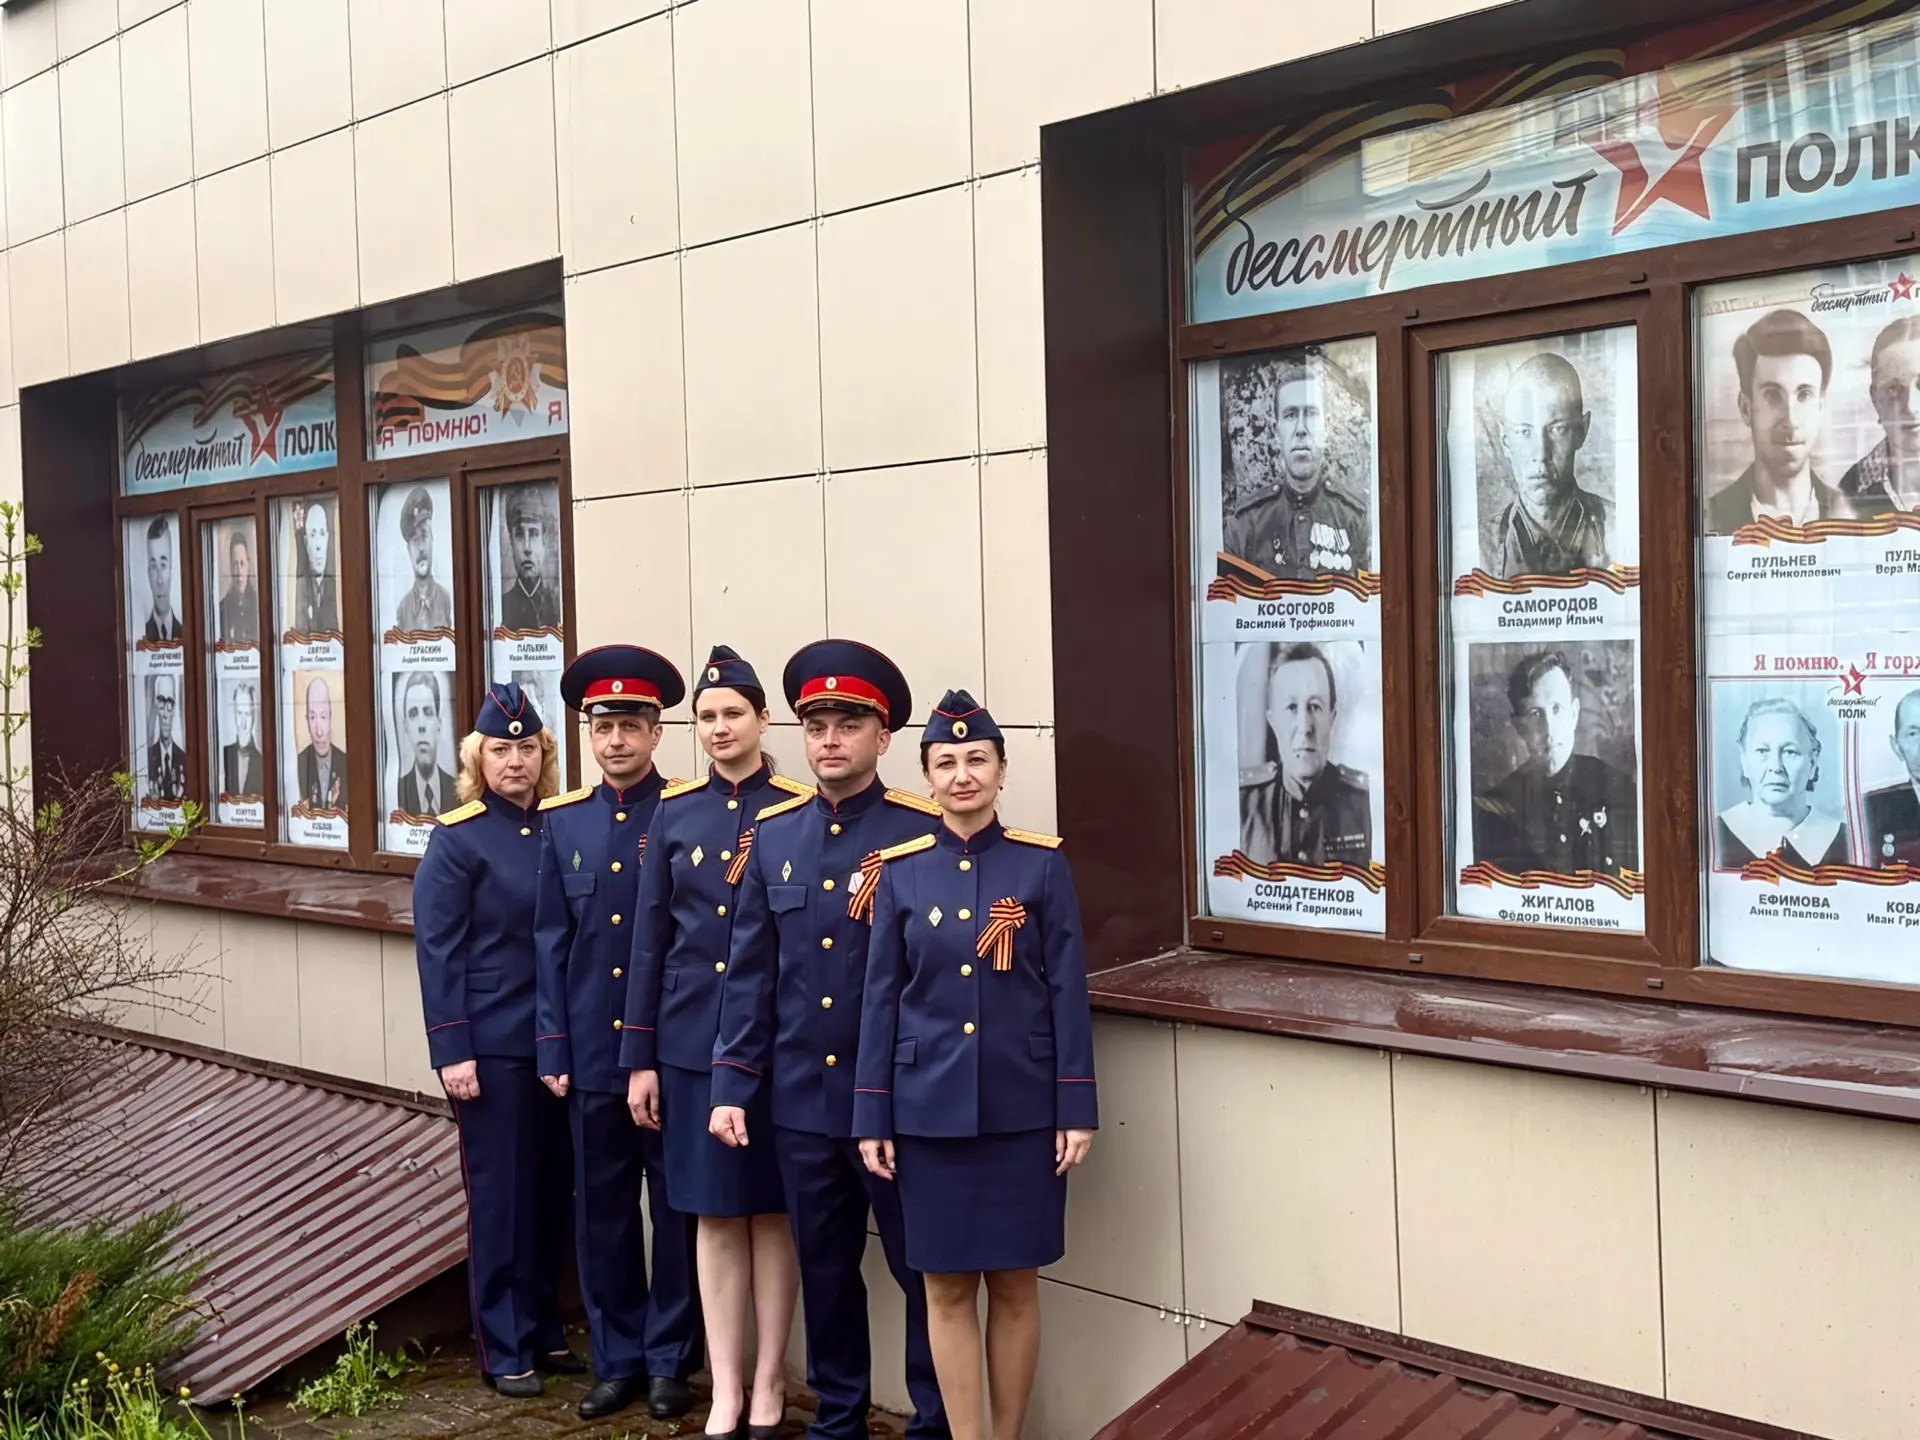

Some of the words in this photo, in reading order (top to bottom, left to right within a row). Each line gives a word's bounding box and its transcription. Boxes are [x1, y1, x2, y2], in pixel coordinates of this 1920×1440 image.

[1226, 158, 1598, 294] бессмертный
[1736, 116, 1920, 204] ПОЛК
[1810, 284, 1890, 312] бессмертный
[382, 426, 395, 450] Я
[408, 413, 488, 447] ПОМНЮ!
[548, 401, 562, 426] Я
[135, 428, 246, 484] бессмертный
[284, 420, 336, 457] ПОЛК
[1751, 554, 1817, 568] ПУЛЬНЕВ
[1727, 570, 1767, 582] Сергей
[1770, 567, 1841, 579] Николаевич
[1875, 563, 1903, 577] Вера
[1257, 602, 1335, 616] КОСОГОРОВ
[1502, 597, 1598, 614] САМОРОДОВ
[1236, 617, 1286, 630] Василий
[1290, 617, 1355, 631] Трофимович
[1497, 614, 1562, 628] Владимир
[1566, 613, 1604, 626] Ильич
[517, 643, 548, 653] ПАЛЬКИН
[1753, 654, 1767, 671] Я
[1865, 652, 1877, 670] Я
[1838, 708, 1867, 719] ПОЛК
[1255, 883, 1355, 903] СОЛДАТЕНКОВ
[1758, 893, 1831, 909] ЕФИМОВА
[1247, 897, 1292, 912] Арсений
[1295, 901, 1363, 917] Гаврилович
[1521, 894, 1595, 912] ЖИГАЛОВ
[1498, 909, 1540, 923] Фёдор
[1544, 912, 1620, 928] Николаевич
[1750, 905, 1780, 918] Анна
[1782, 907, 1840, 921] Павловна
[1867, 912, 1895, 925] Иван
